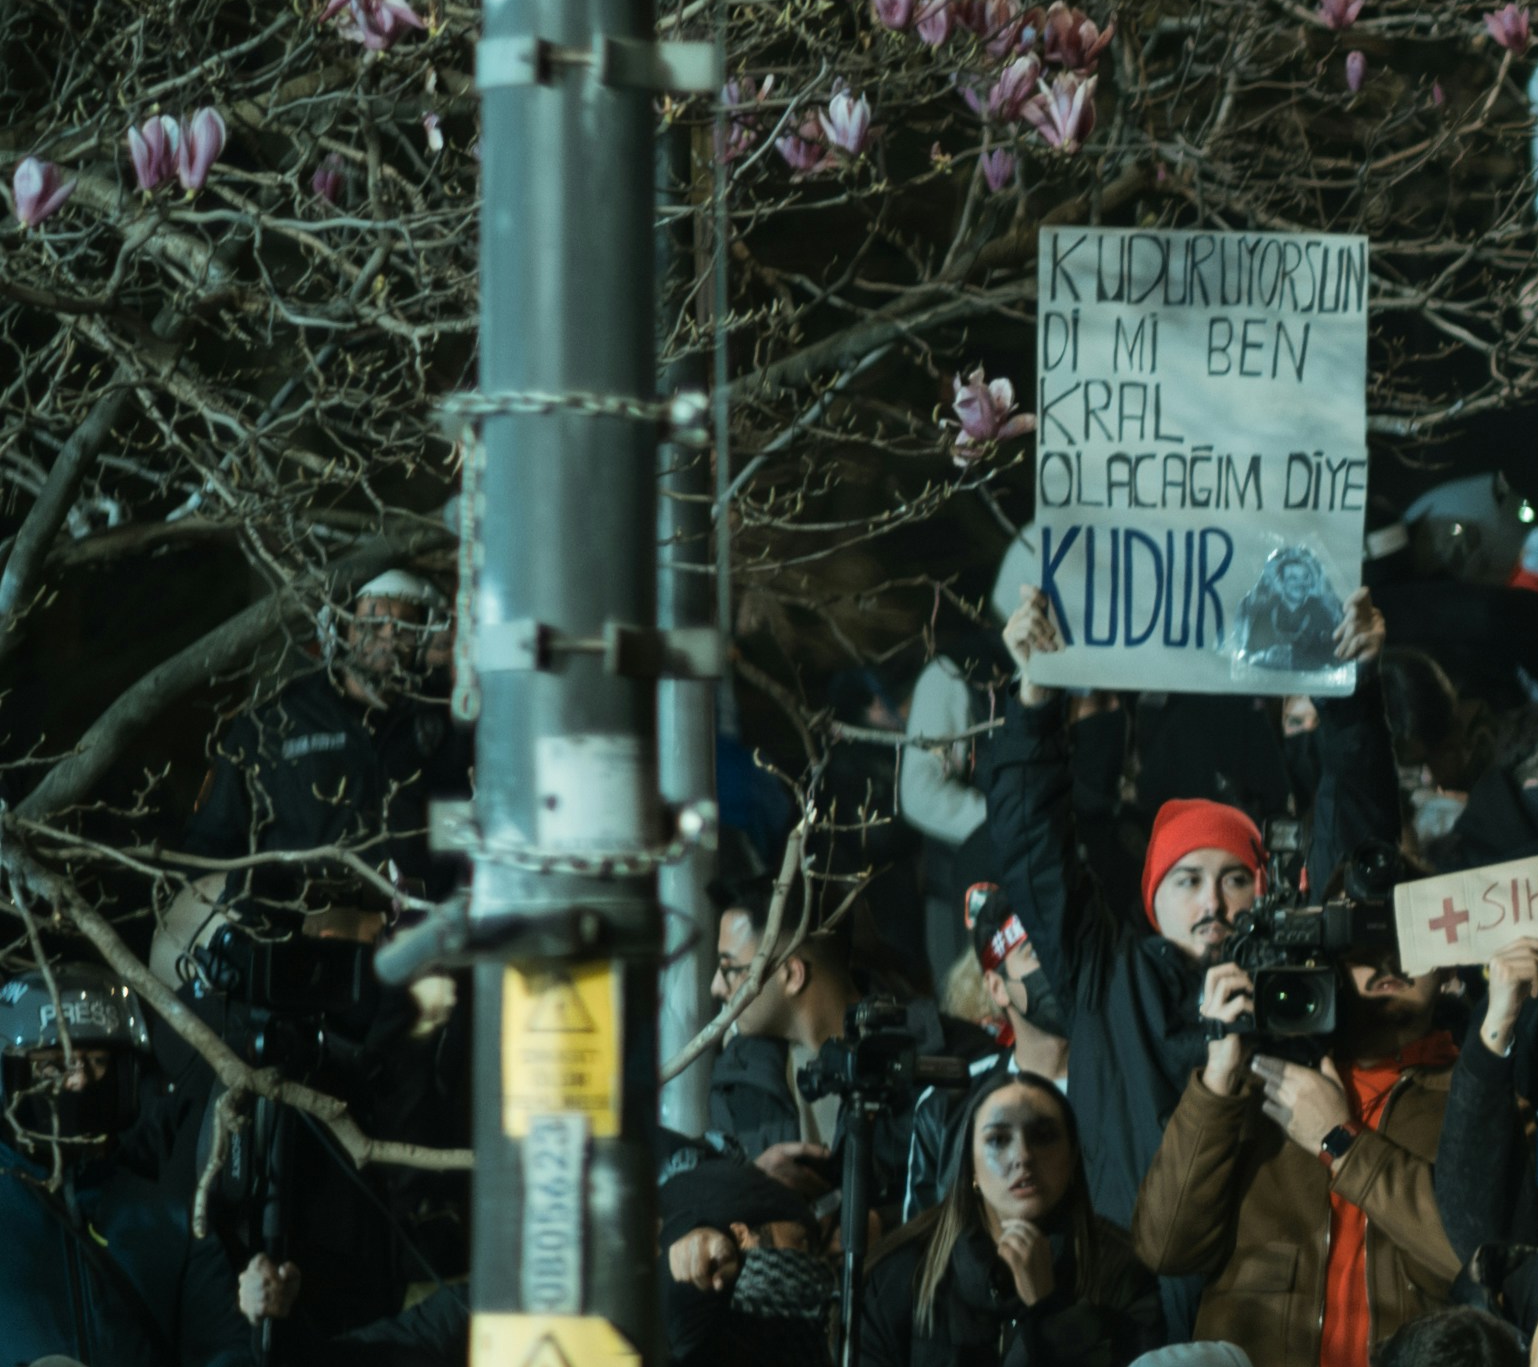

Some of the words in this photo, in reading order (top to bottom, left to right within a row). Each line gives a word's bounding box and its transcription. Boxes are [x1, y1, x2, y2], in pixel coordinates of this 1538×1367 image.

[1050, 233, 1367, 314] KUDURUYORSUN
[1207, 316, 1311, 383] BEN
[1039, 377, 1185, 446] KRAL
[1040, 445, 1264, 512] OLACAĞIM
[1041, 524, 1235, 648] KUDUR
